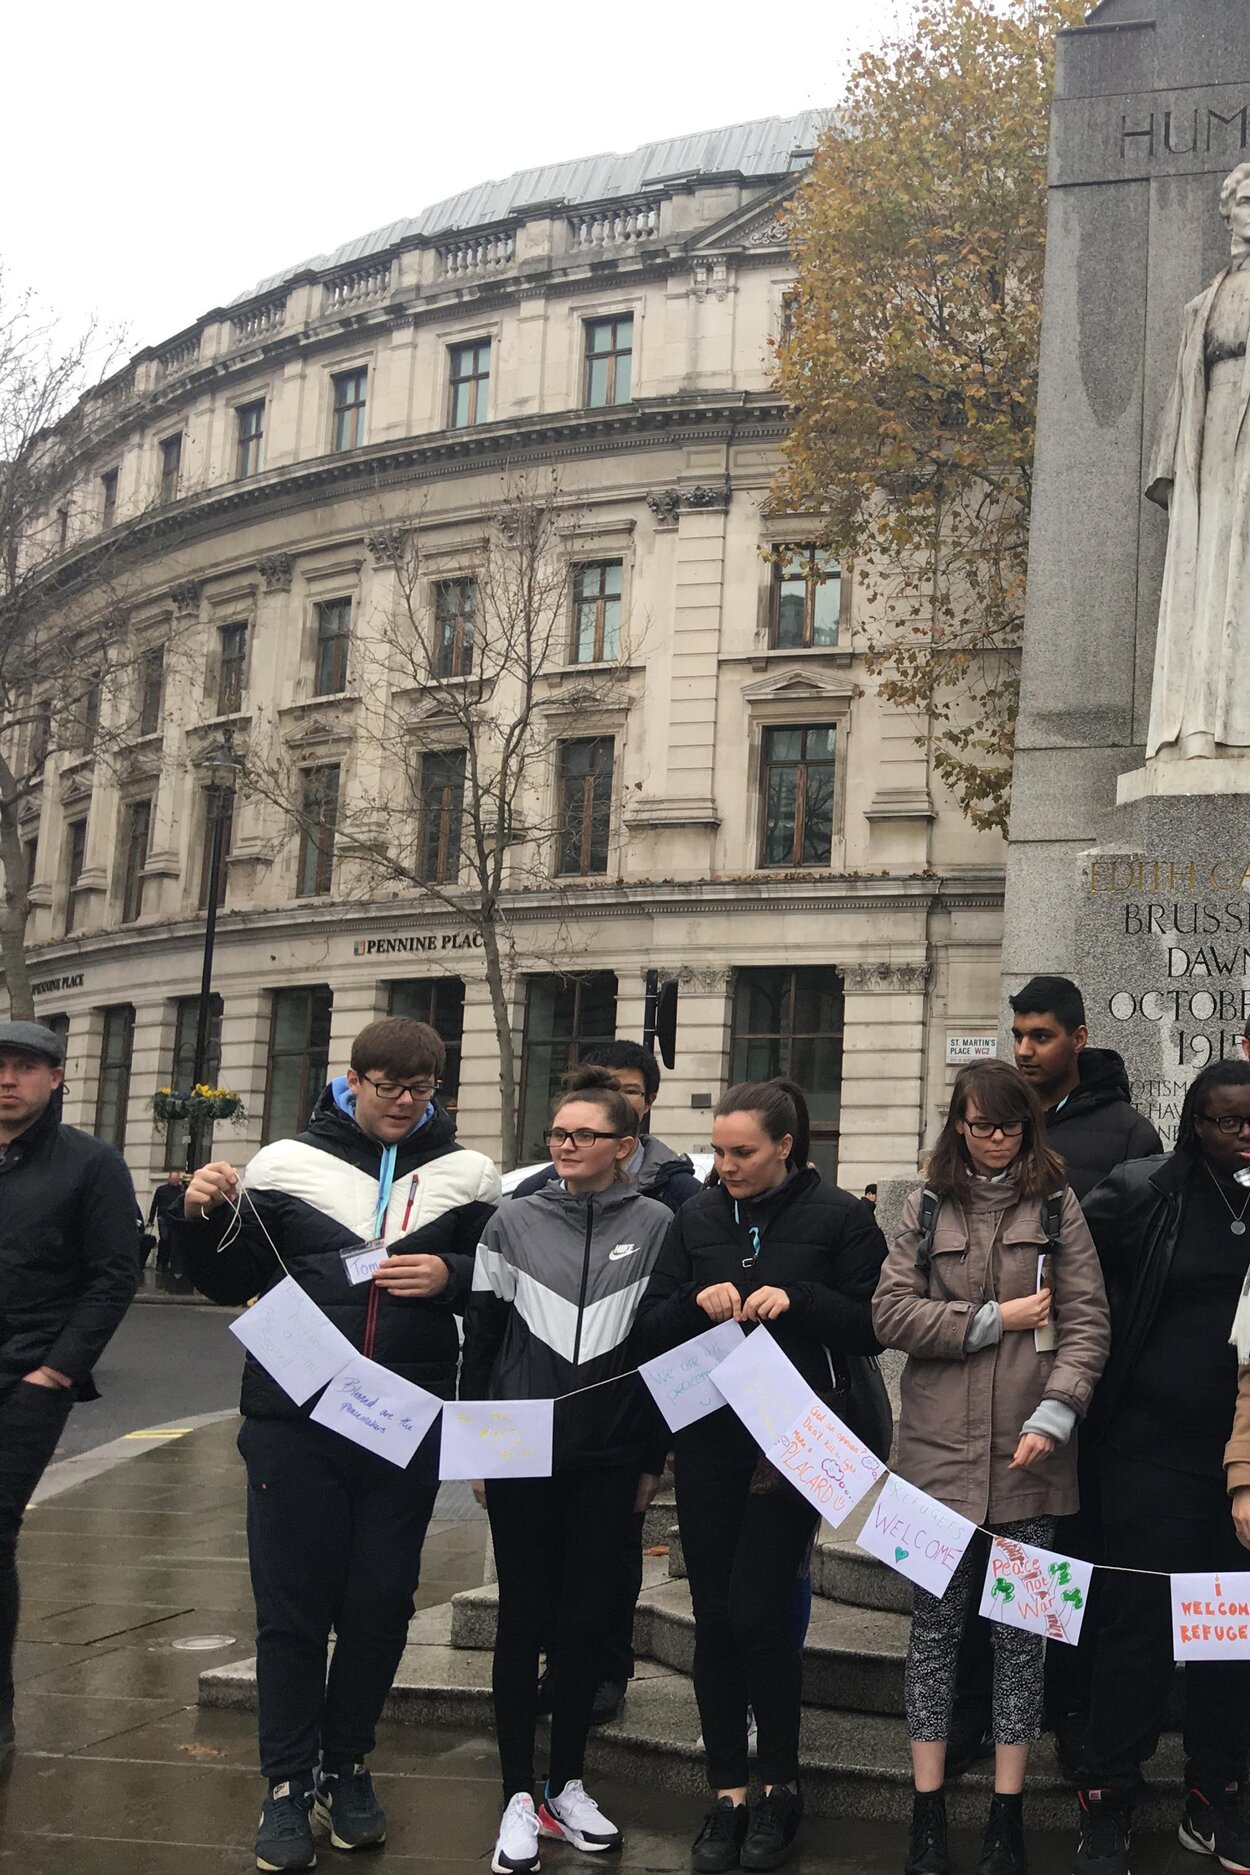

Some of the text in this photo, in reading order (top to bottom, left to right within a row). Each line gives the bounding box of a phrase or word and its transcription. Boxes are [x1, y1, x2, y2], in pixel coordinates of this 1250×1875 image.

[1090, 860, 1196, 893] EDITH
[366, 932, 488, 954] PENNINE PLAC
[1130, 1080, 1188, 1098] OTISM
[613, 1243, 635, 1254] NIKE
[780, 1440, 834, 1504] PLACARD
[889, 1482, 966, 1542] REFUGEES
[874, 1503, 964, 1572] WELCOME
[991, 1557, 1041, 1579] Peace
[1025, 1577, 1049, 1594] not
[1017, 1597, 1056, 1621] War
